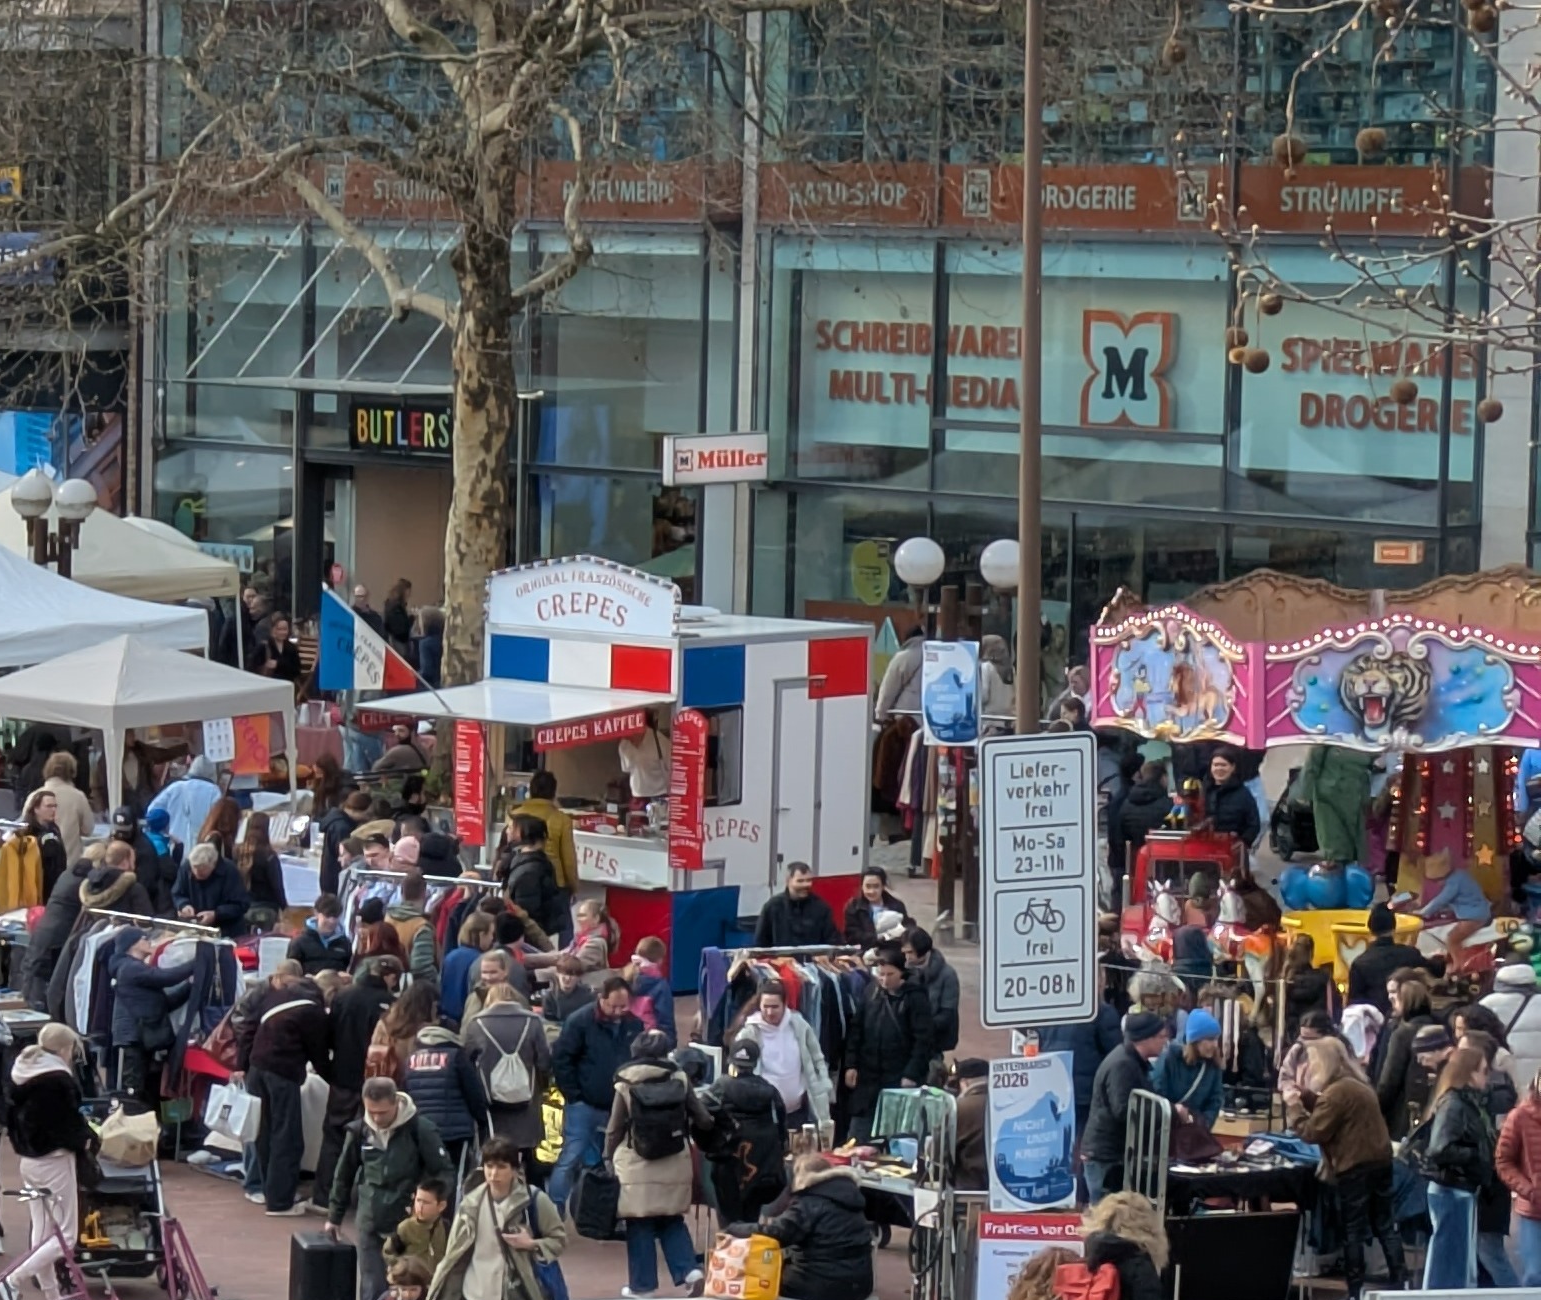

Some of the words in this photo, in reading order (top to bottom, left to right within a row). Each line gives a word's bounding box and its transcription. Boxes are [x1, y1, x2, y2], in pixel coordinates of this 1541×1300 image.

[357, 408, 450, 448] BUTLERS
[698, 449, 768, 469] Müller
[515, 571, 567, 598] ORIGINAL
[537, 591, 629, 628] CREPES
[1010, 762, 1067, 780] Liefer-
[1006, 782, 1071, 800] verkehr
[1025, 802, 1053, 819] frei
[1013, 833, 1066, 853] Mo-Sa
[1026, 939, 1054, 957] frei
[993, 1073, 1029, 1089] 2026
[1041, 1224, 1063, 1236] vor
